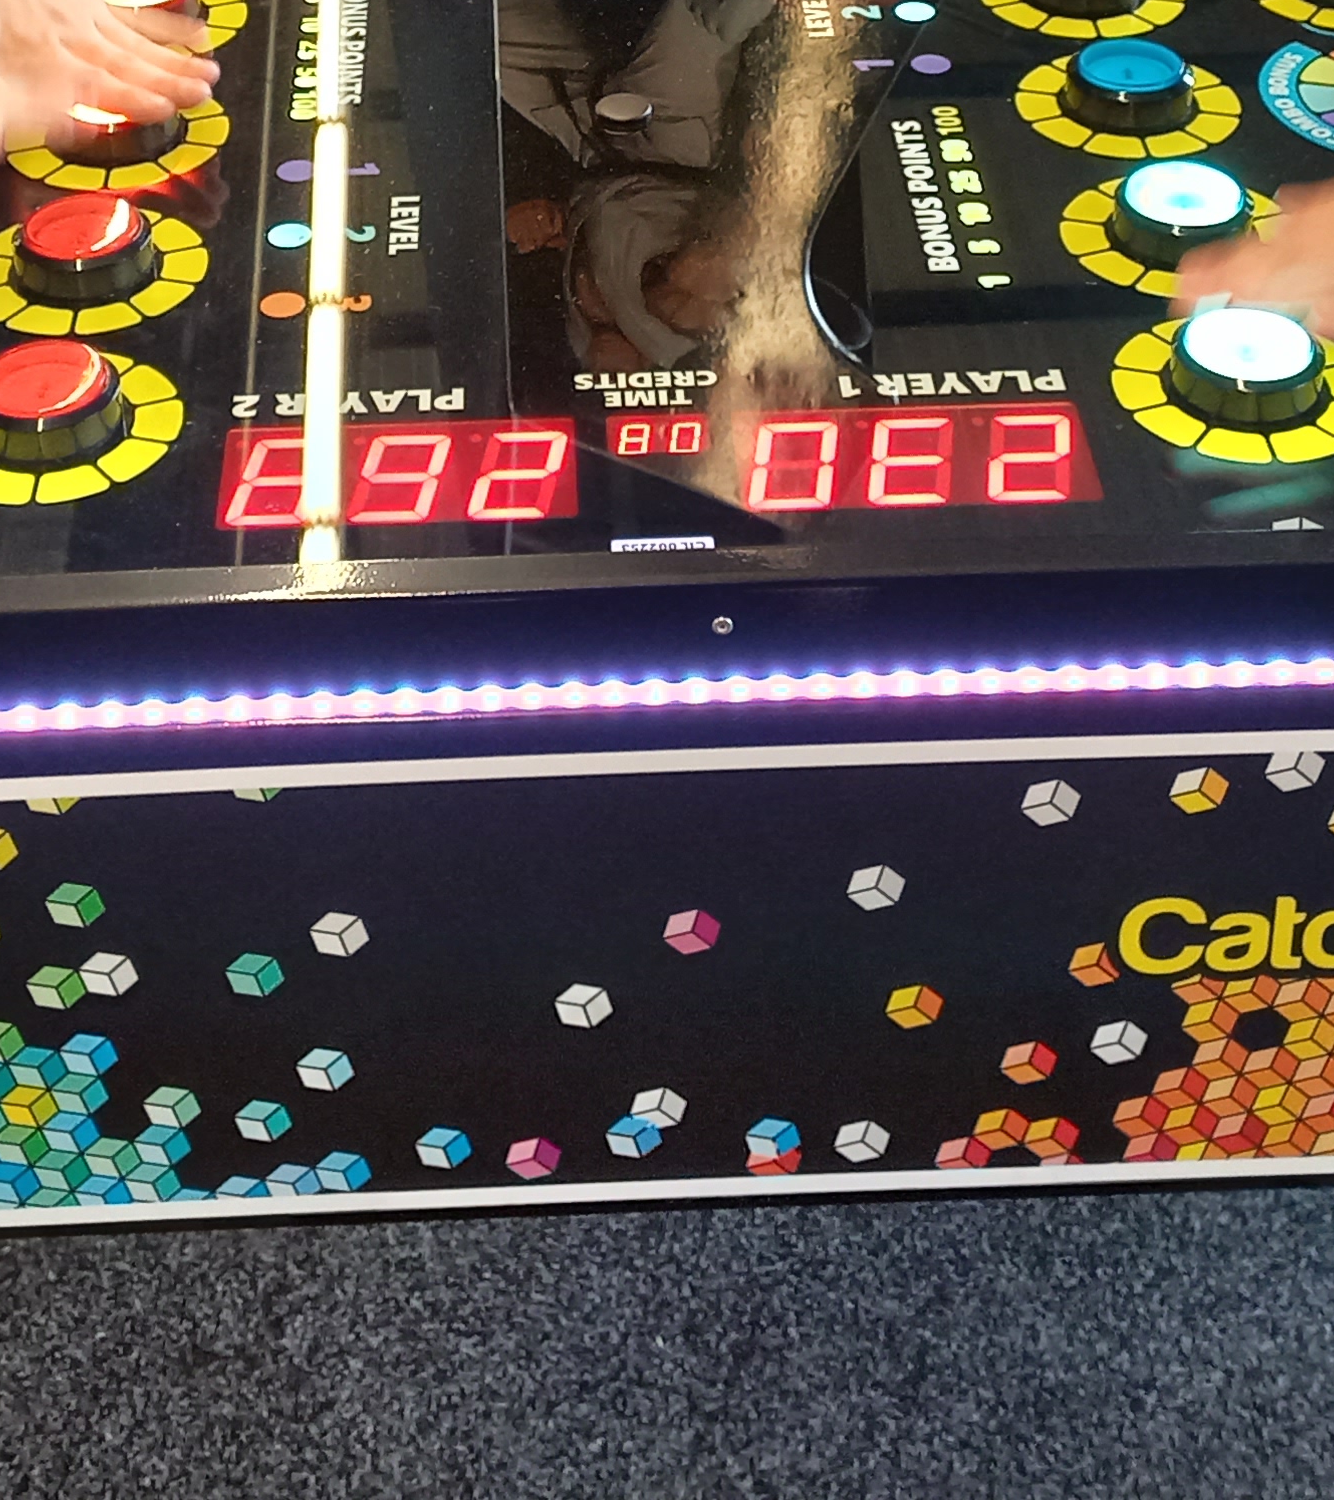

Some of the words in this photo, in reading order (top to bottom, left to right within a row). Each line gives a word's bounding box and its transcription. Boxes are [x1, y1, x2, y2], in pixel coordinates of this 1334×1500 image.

[841, 4, 883, 20] 2
[338, 39, 366, 106] POINTS
[852, 59, 895, 72] 1
[1268, 51, 1304, 96] BONUS
[931, 105, 964, 136] 100
[891, 119, 939, 193] POINTS
[387, 195, 421, 256] LEVEL
[911, 196, 961, 272] BONUS
[967, 238, 1001, 255] 5
[977, 275, 1011, 289] 1
[573, 369, 718, 391] CREDITS
[837, 374, 862, 399] 1
[872, 368, 1068, 397] PLAYER
[230, 394, 260, 418] 2
[274, 387, 466, 417] PLAYR
[603, 388, 693, 408] TIME
